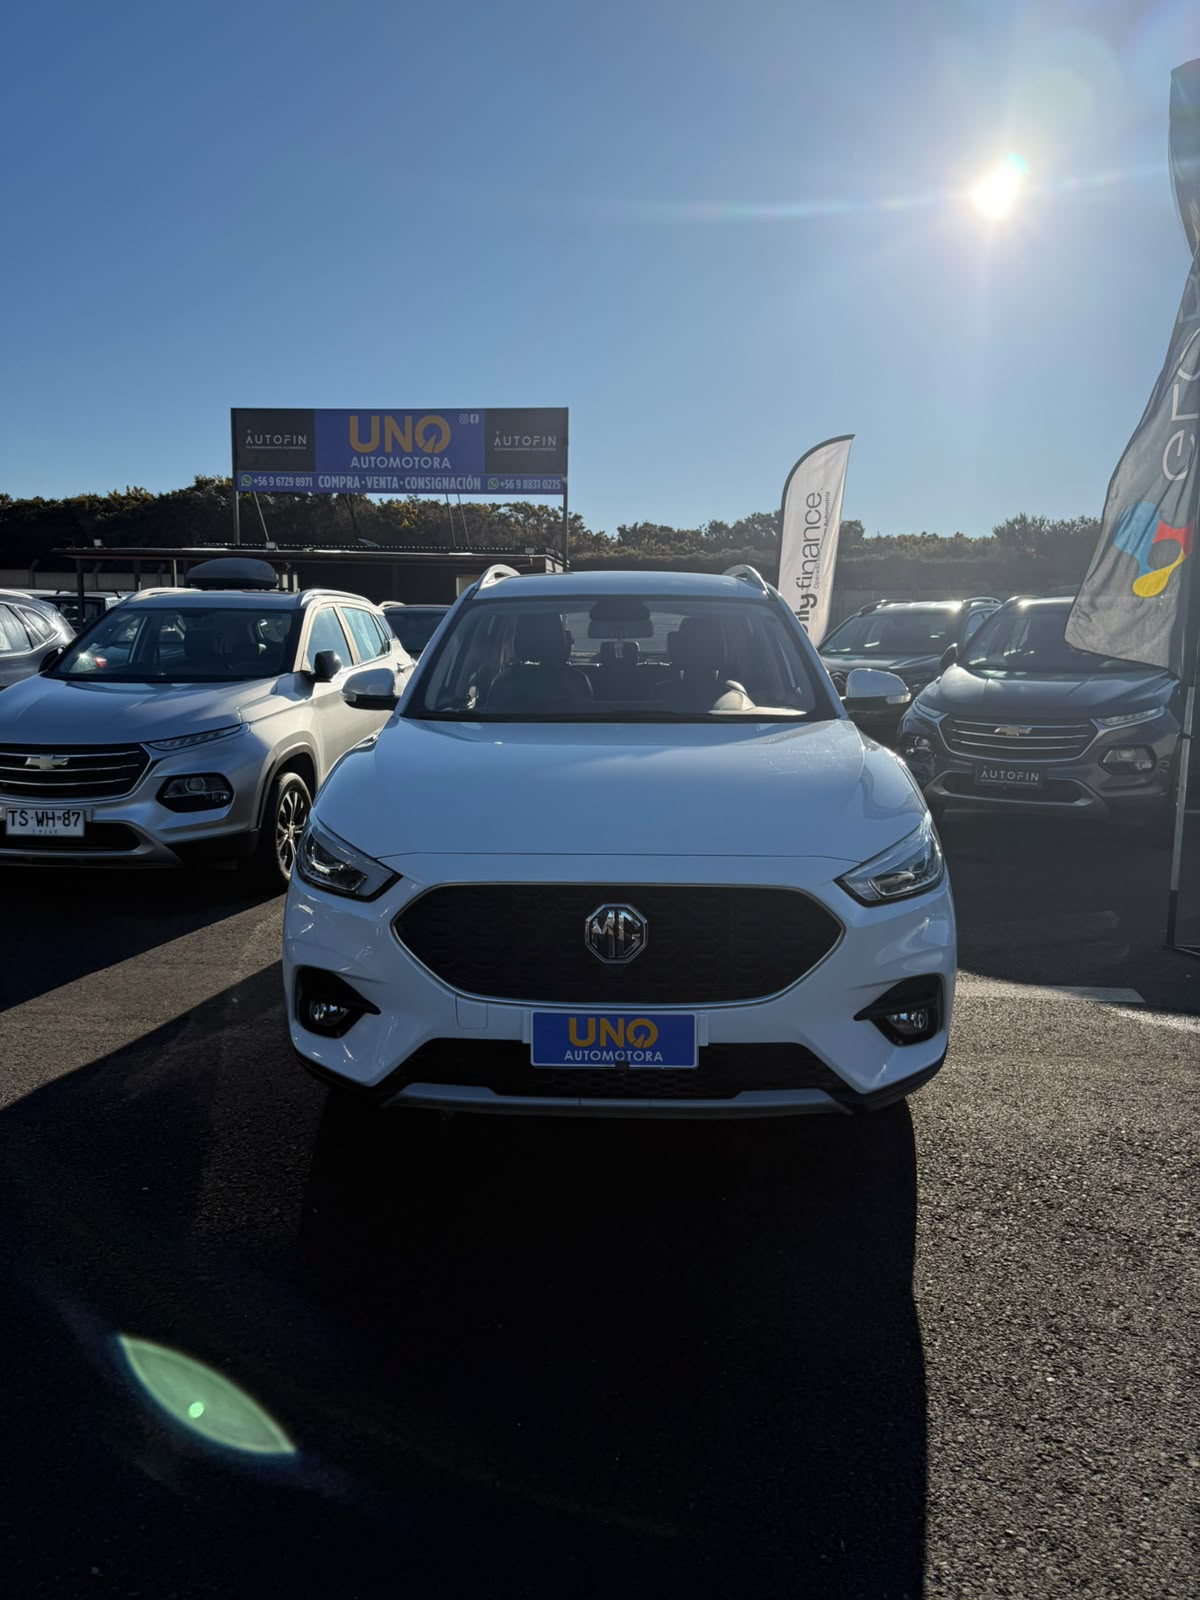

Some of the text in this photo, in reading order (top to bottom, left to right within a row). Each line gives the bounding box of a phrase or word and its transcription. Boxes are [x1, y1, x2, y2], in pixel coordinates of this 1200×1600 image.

[246, 434, 307, 445] AUTOFIN
[350, 415, 451, 453] UNO
[494, 435, 557, 446] AUTOFIN
[350, 456, 452, 469] AUTOMOTORA
[269, 475, 275, 486] 9
[276, 475, 294, 487] 6729
[295, 476, 313, 487] 8971
[516, 479, 522, 489] 9
[981, 770, 1040, 781] AUTOFIN
[590, 910, 642, 959] MG
[568, 1017, 659, 1049] UNO
[564, 1050, 664, 1062] AUTOMOTORA
